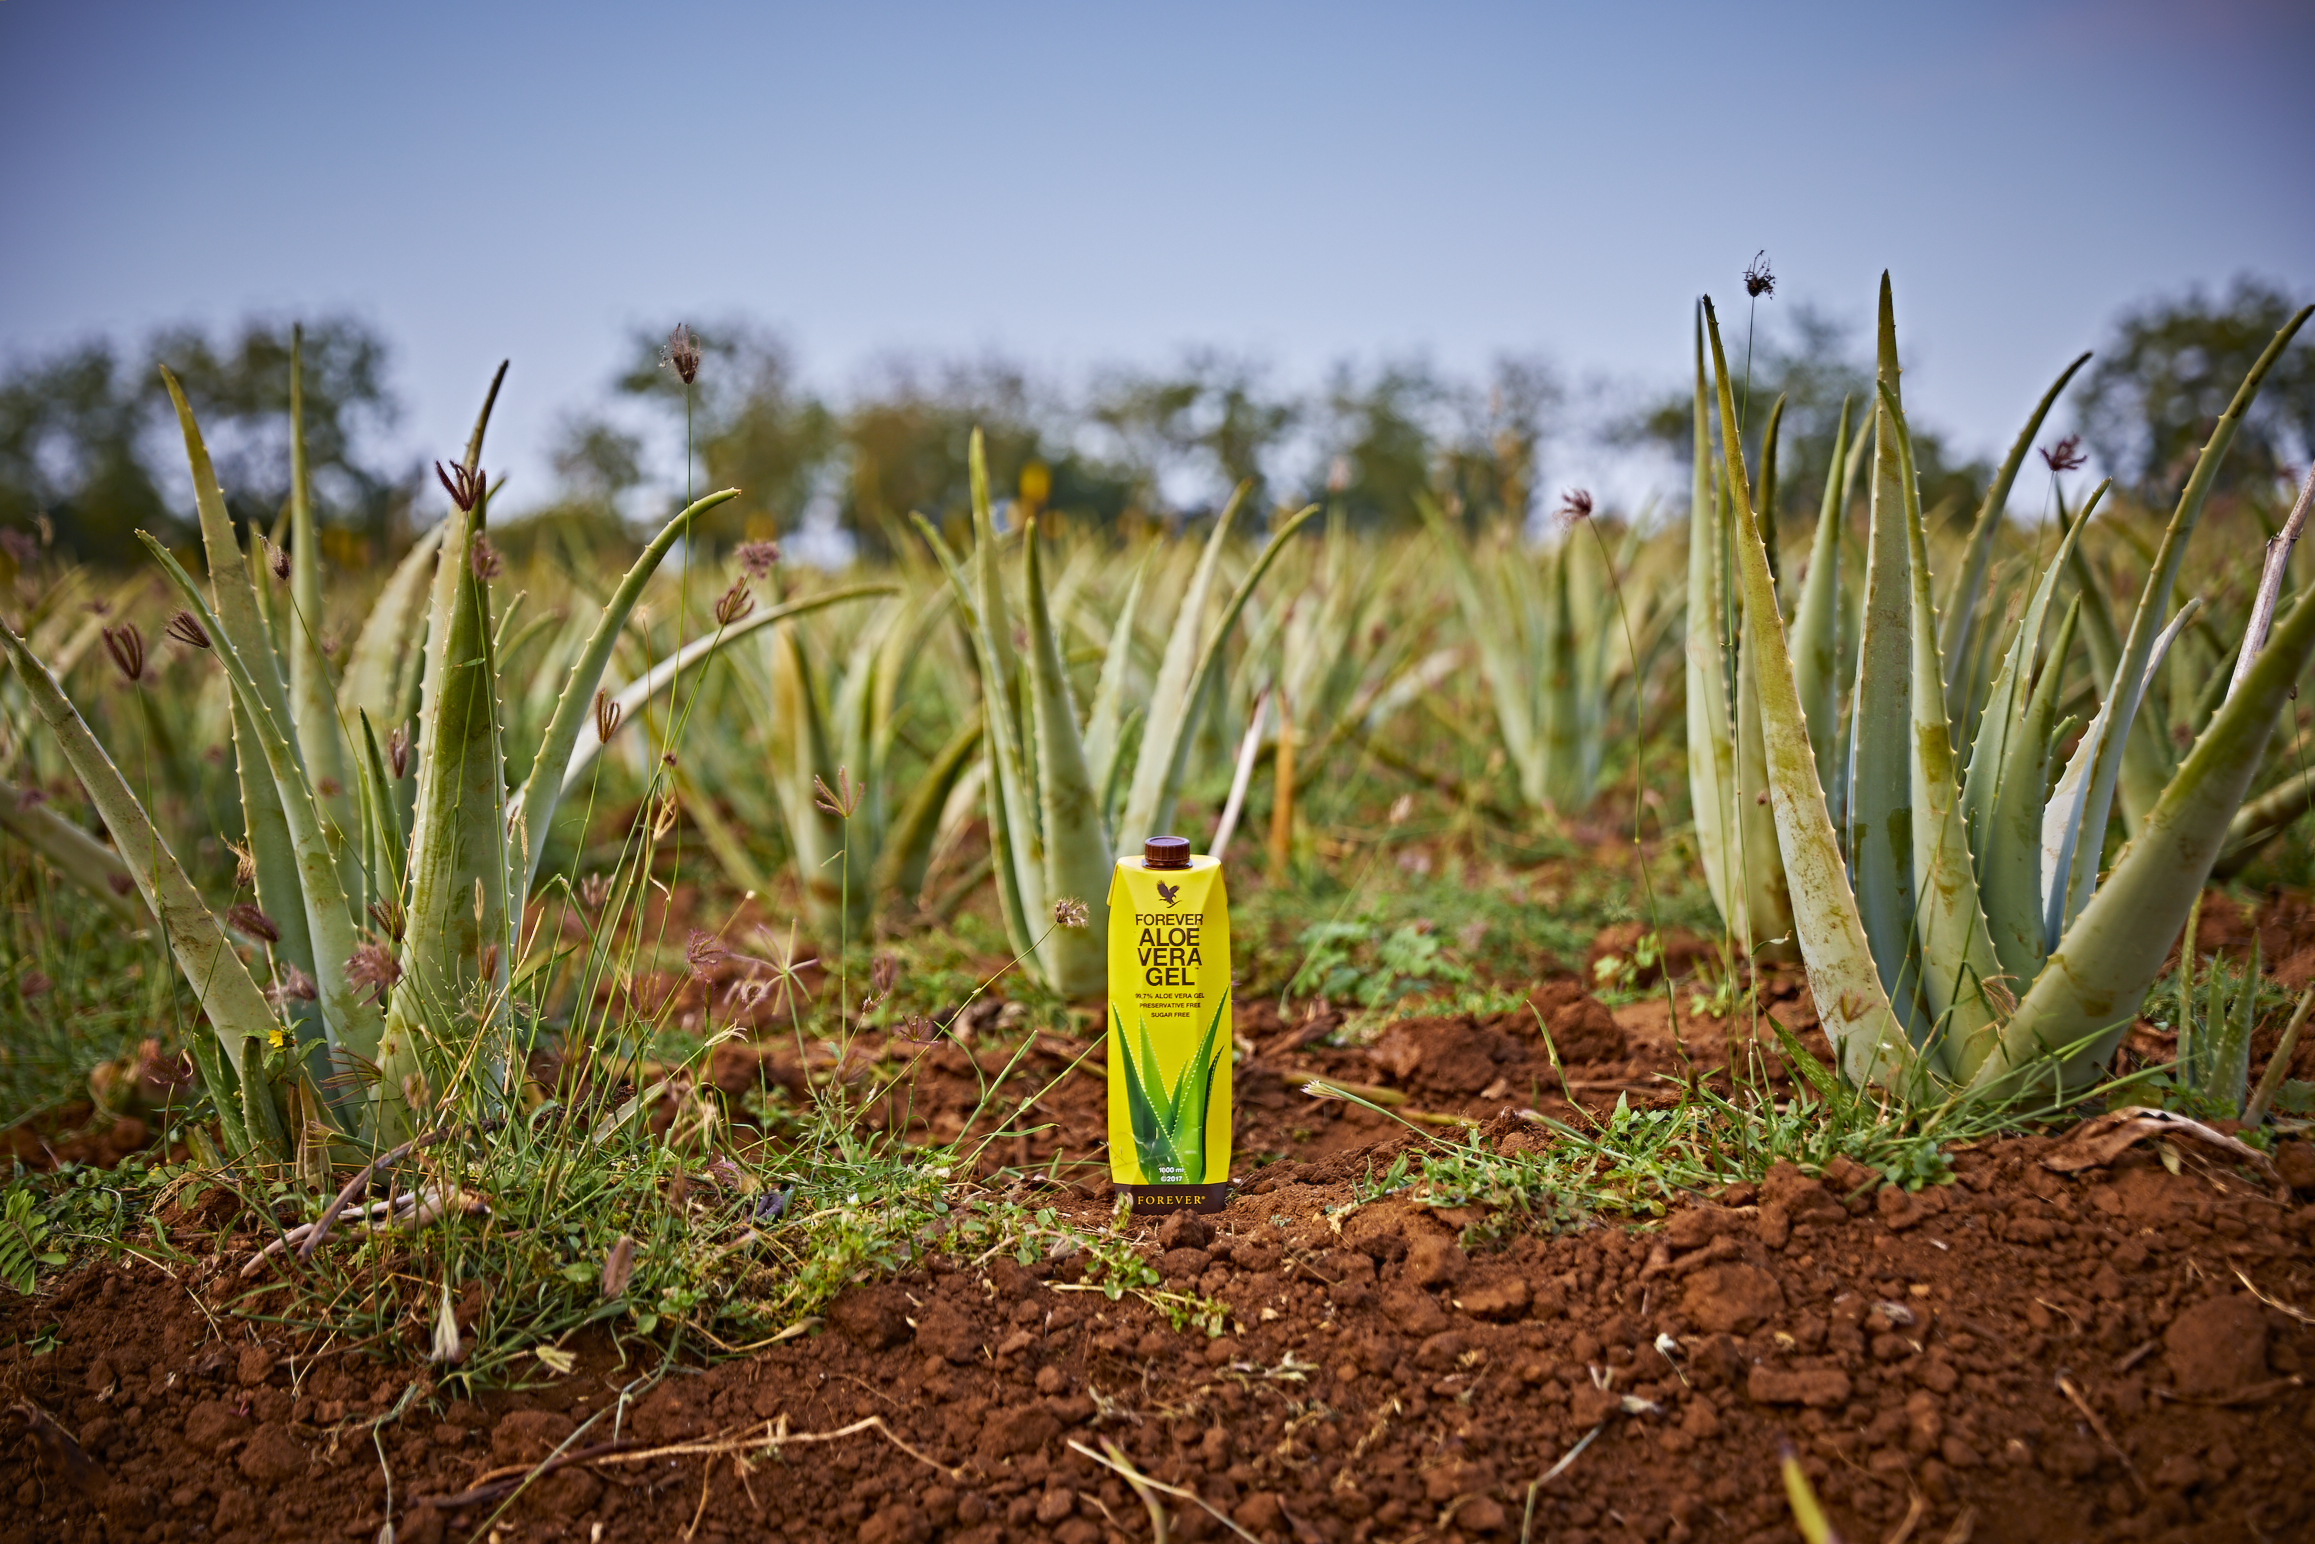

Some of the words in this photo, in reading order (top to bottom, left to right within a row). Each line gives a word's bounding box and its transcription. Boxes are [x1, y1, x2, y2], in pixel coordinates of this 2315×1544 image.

[1135, 913, 1204, 926] FOREVER
[1139, 927, 1200, 947] ALOE
[1137, 947, 1203, 966] VERA
[1145, 967, 1195, 987] GEL
[1158, 1166, 1175, 1174] 1000
